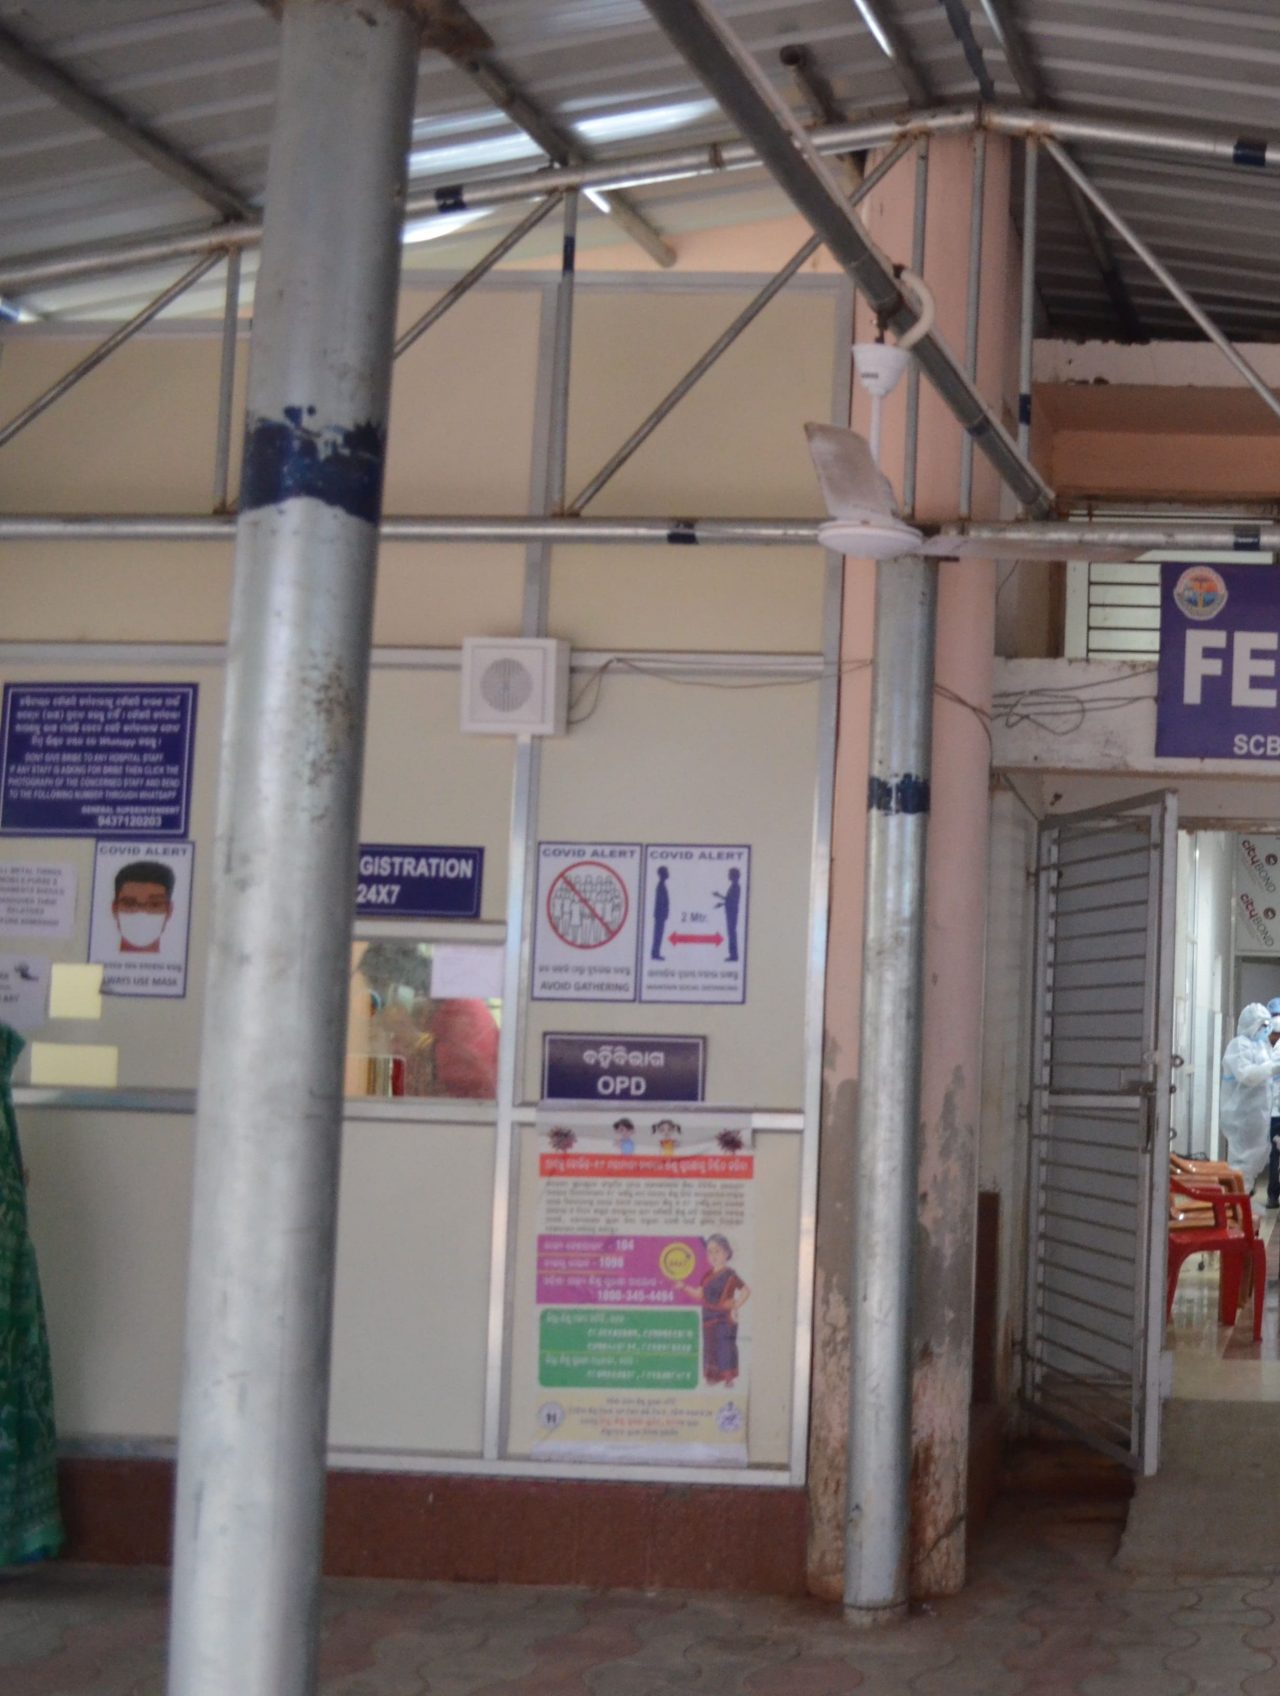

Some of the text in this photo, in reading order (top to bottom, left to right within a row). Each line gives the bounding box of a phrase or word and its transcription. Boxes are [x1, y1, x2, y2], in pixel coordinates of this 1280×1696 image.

[542, 847, 637, 859] COVID ALERT
[650, 851, 745, 861] COVID ALERT
[360, 856, 473, 879] GISTRATION
[356, 883, 401, 905] 24X7
[681, 913, 687, 922] 2
[133, 976, 149, 985] USE
[540, 981, 630, 992] AVOID GATHERING
[597, 1076, 647, 1096] OPD
